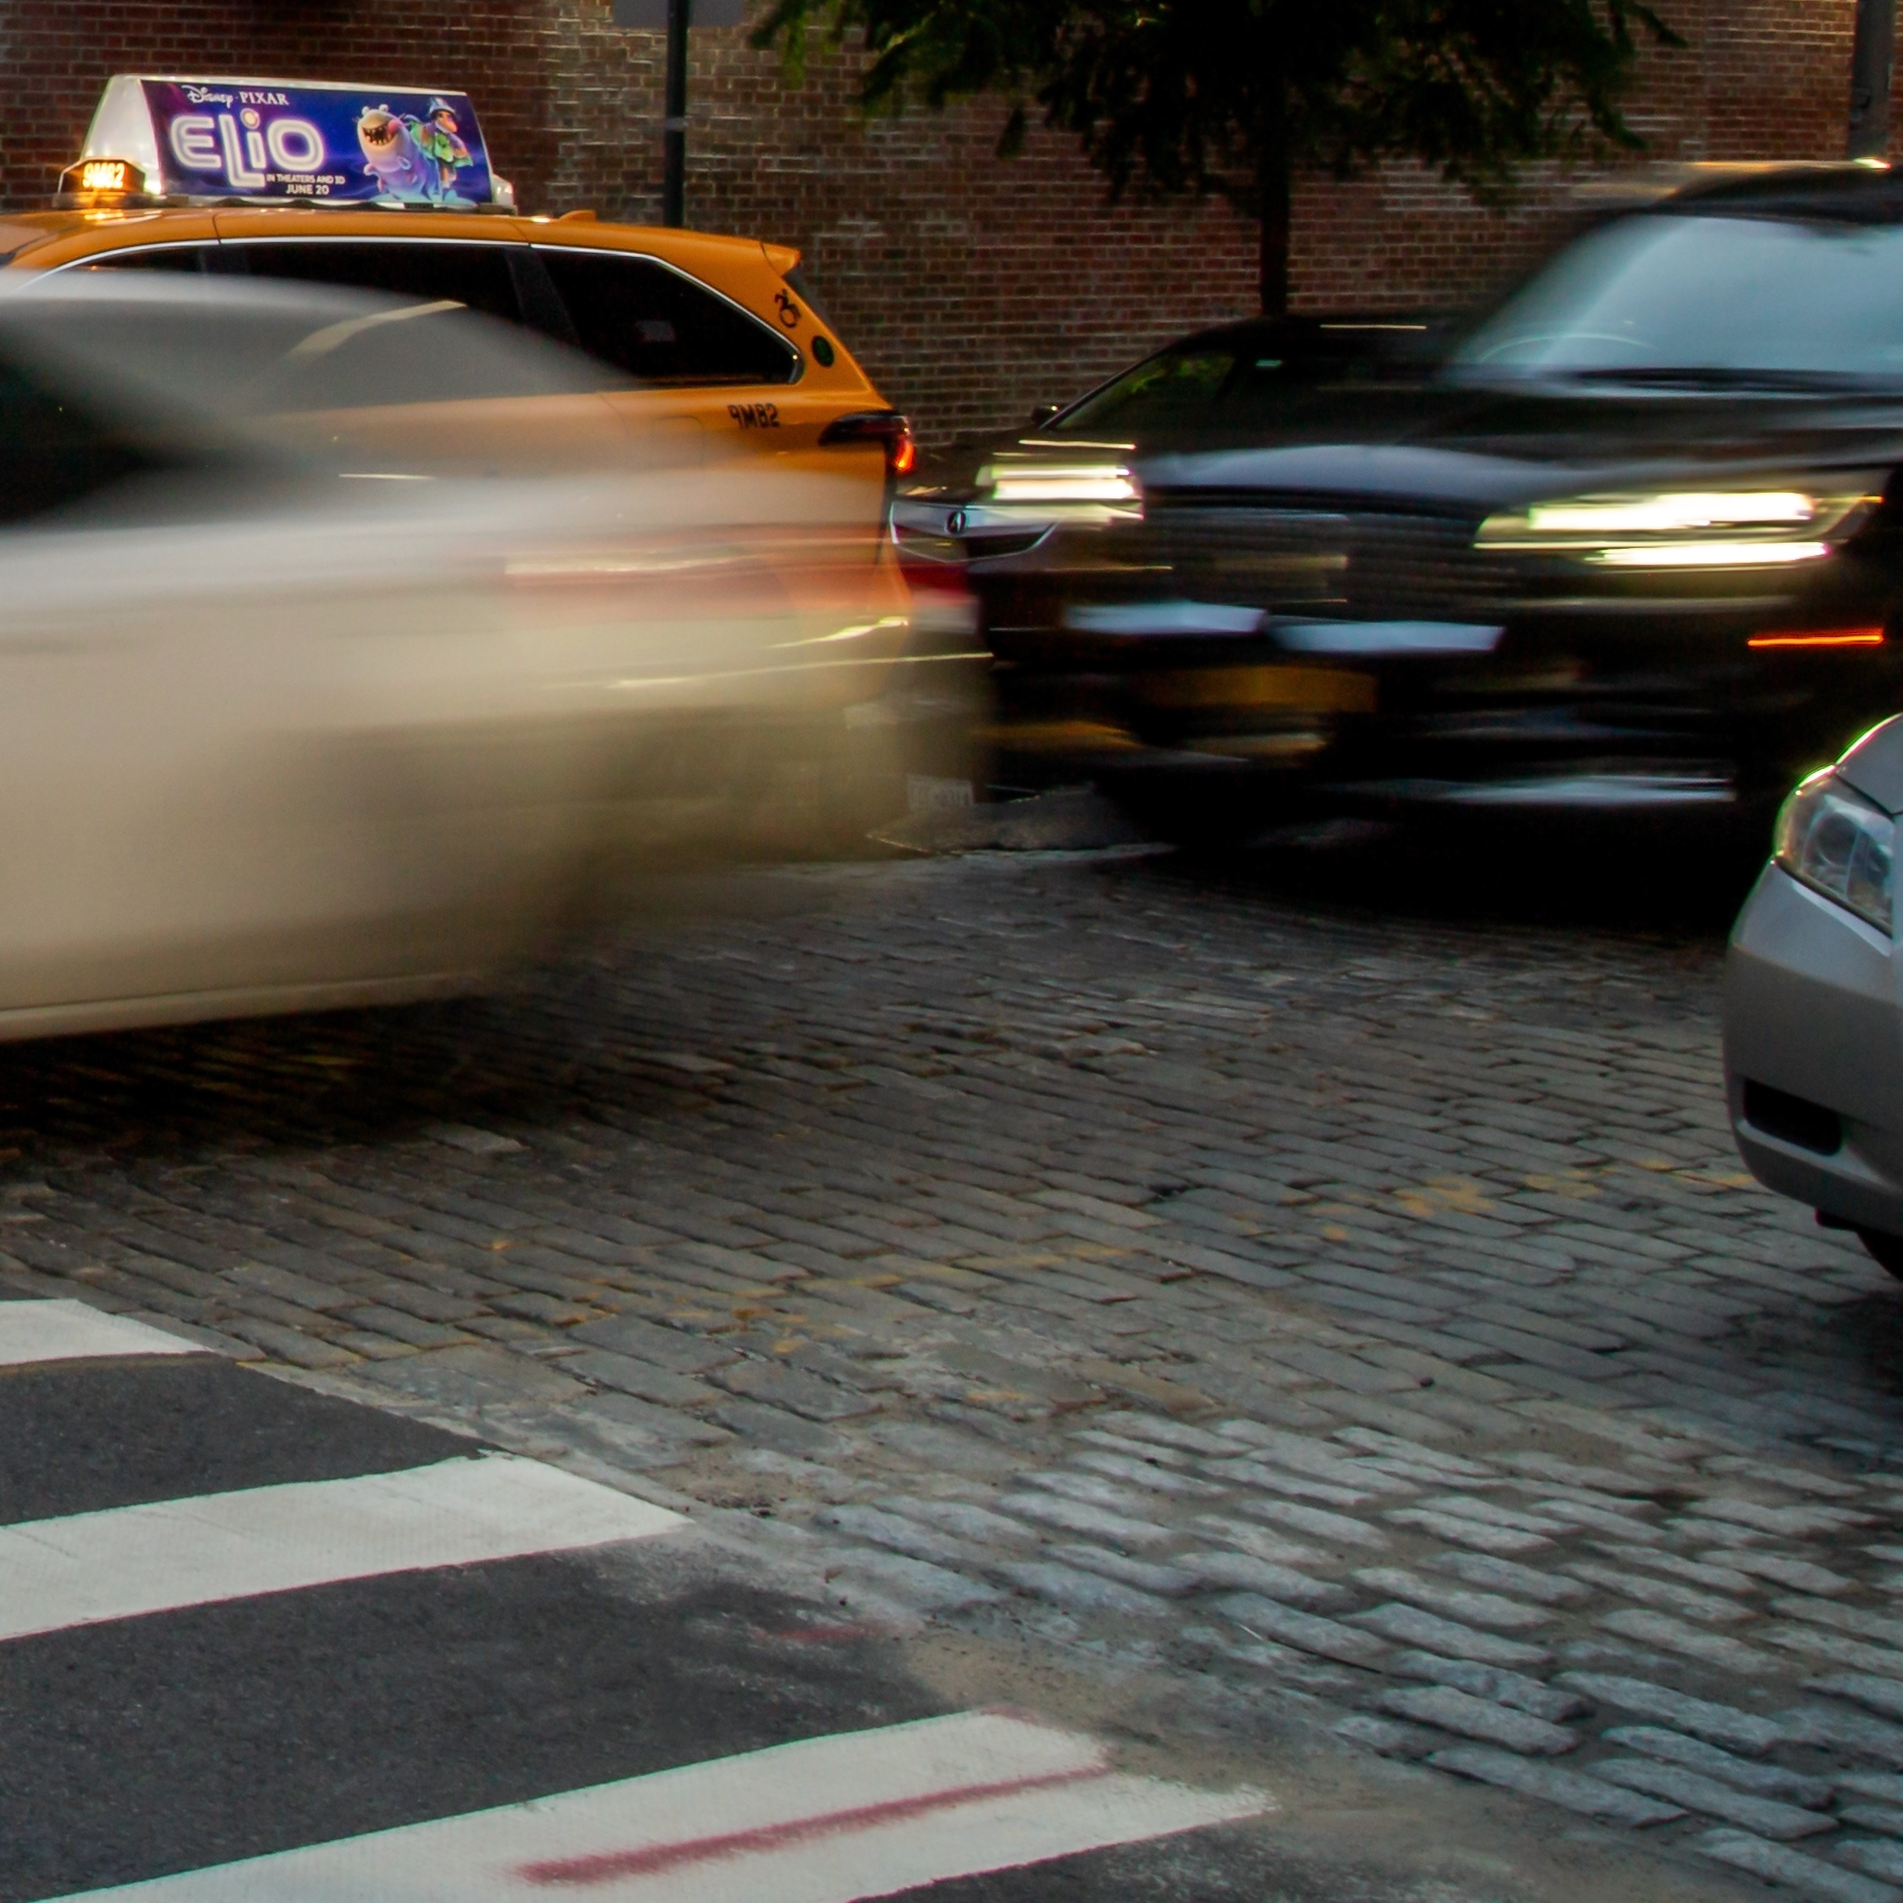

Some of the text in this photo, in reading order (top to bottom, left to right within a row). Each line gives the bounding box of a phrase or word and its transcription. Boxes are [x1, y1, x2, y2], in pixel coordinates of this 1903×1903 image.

[181, 85, 290, 109] Disney PIXAR
[266, 173, 276, 182] IN
[277, 173, 316, 184] THEATERS
[316, 175, 334, 184] AND
[285, 184, 330, 195] JUNE 20
